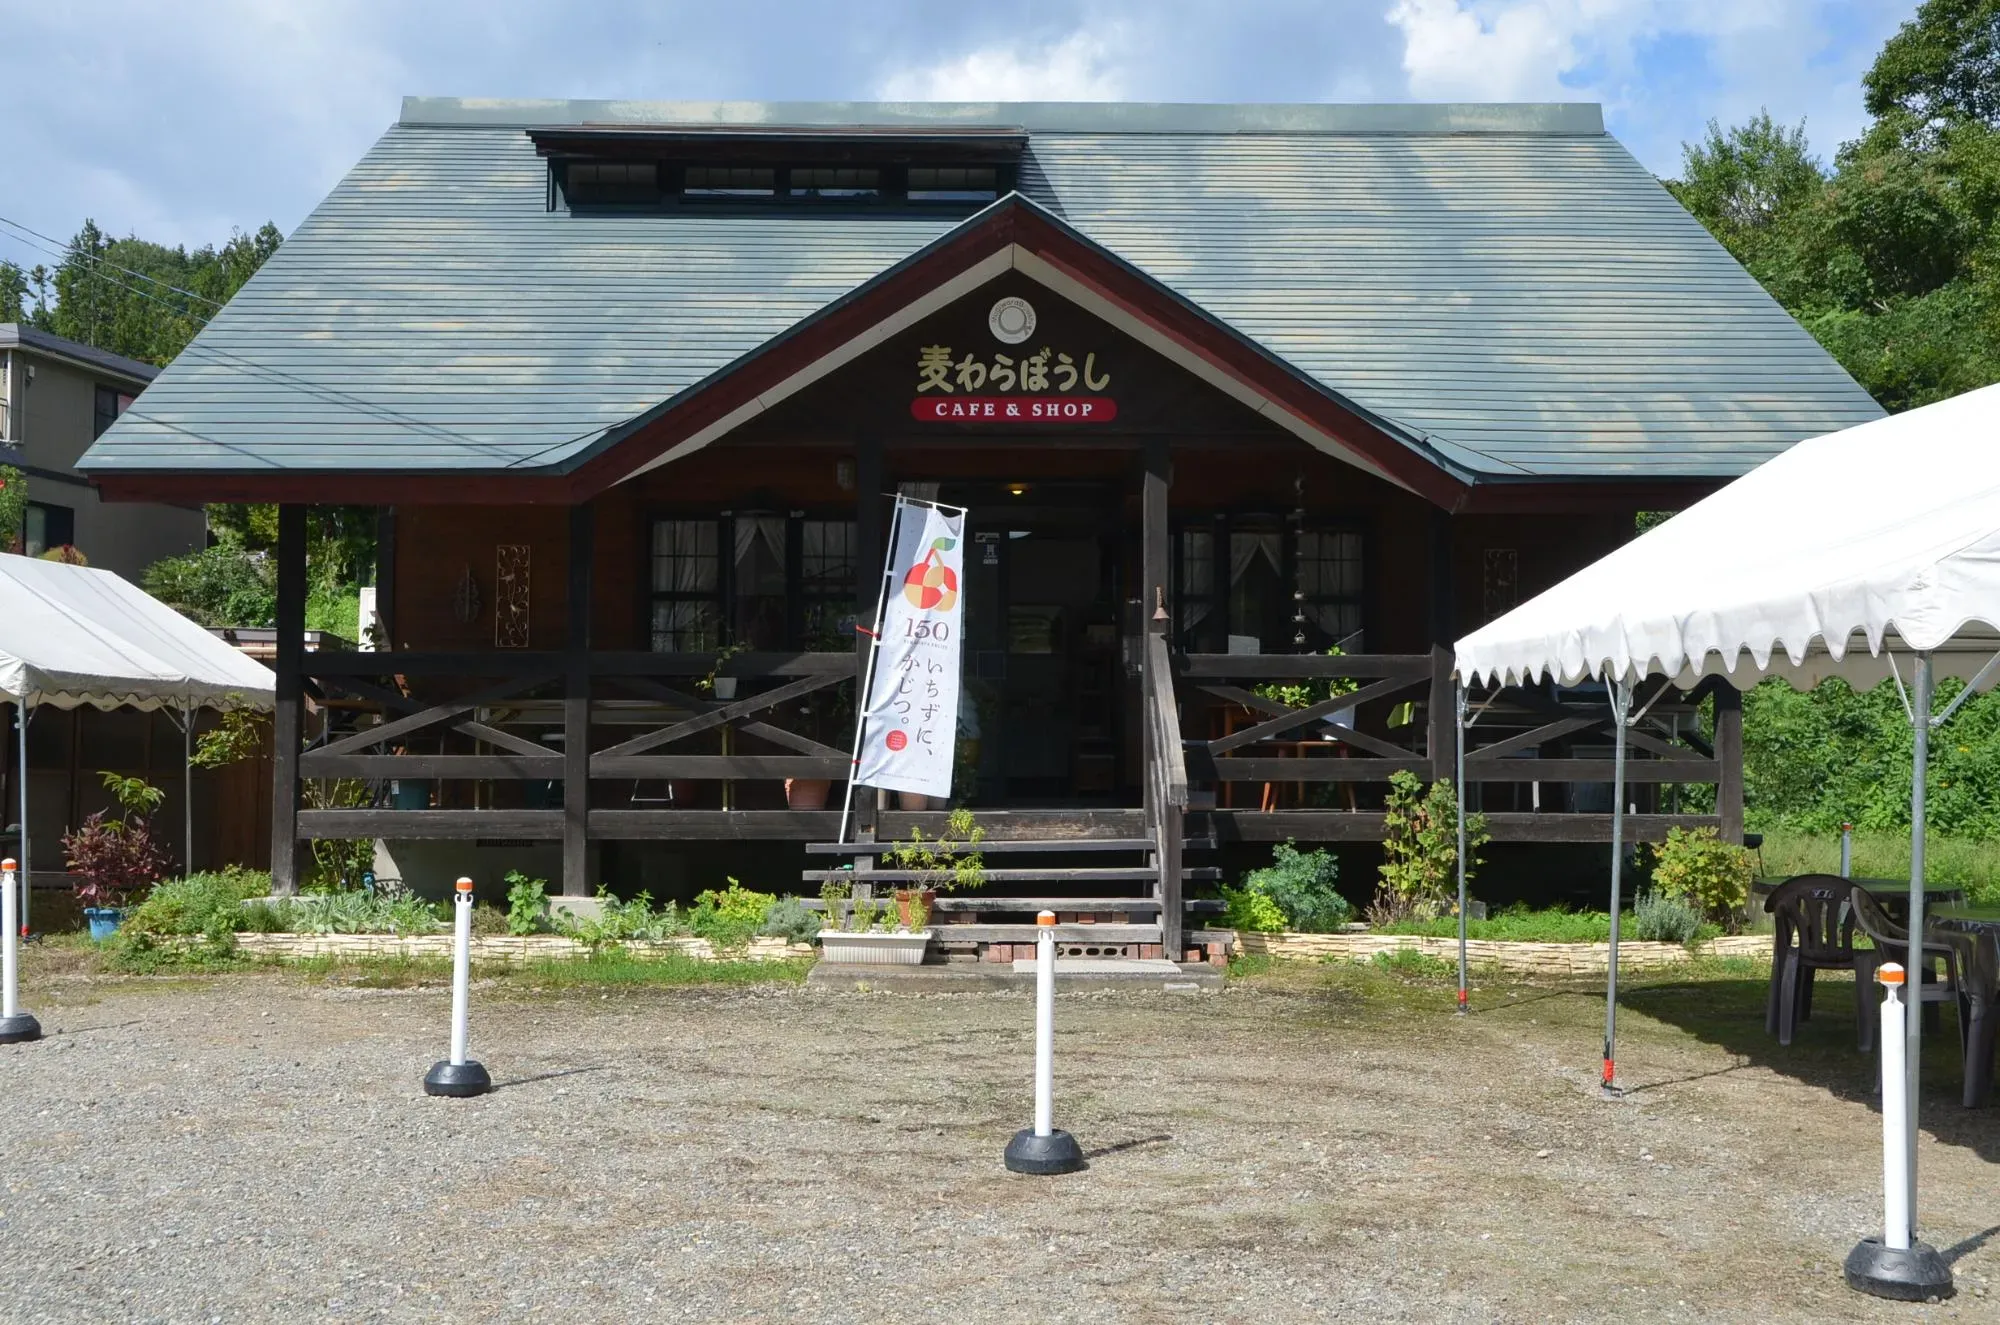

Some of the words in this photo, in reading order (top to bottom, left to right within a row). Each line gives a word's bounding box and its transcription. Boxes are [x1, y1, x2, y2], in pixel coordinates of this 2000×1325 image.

[917, 344, 1110, 393] 麦わらぼうし
[935, 403, 996, 417] CAFE
[1006, 403, 1021, 417] &
[1032, 403, 1093, 417] SHOP
[904, 617, 949, 642] 150
[894, 654, 920, 725] かじつ。
[916, 658, 943, 756] いちずに、
